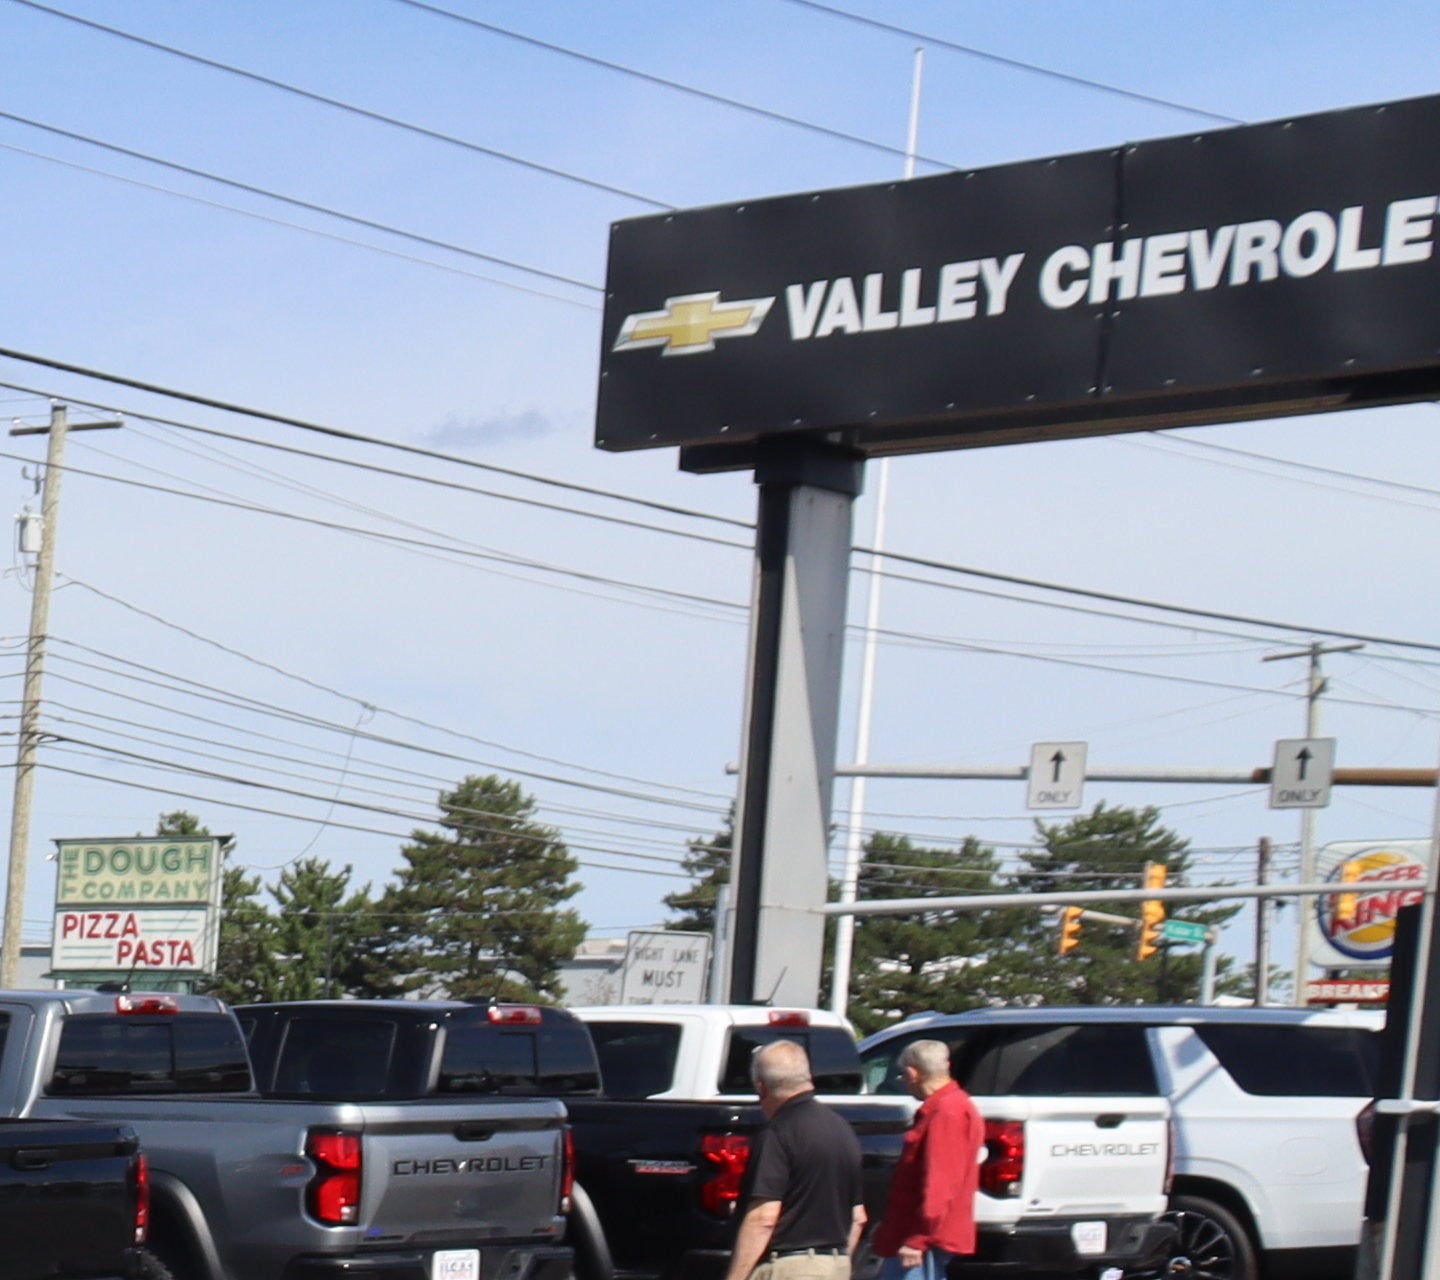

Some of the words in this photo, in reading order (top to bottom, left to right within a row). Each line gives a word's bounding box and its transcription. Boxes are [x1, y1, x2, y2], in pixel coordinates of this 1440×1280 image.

[786, 253, 1025, 340] VALLEY
[1040, 195, 1440, 311] CHEVROLE
[1037, 790, 1072, 804] ONLY
[1280, 788, 1322, 803] ONLY
[83, 845, 210, 877] DOUGH
[62, 851, 78, 898] THE
[82, 880, 209, 900] COMPANY
[62, 912, 140, 940] PIZZA
[117, 939, 196, 967] PASTA
[673, 948, 700, 963] LANE
[642, 969, 685, 988] MUST
[1050, 1143, 1159, 1157] CHEVROLET
[393, 1155, 551, 1176] CHEVROLET
